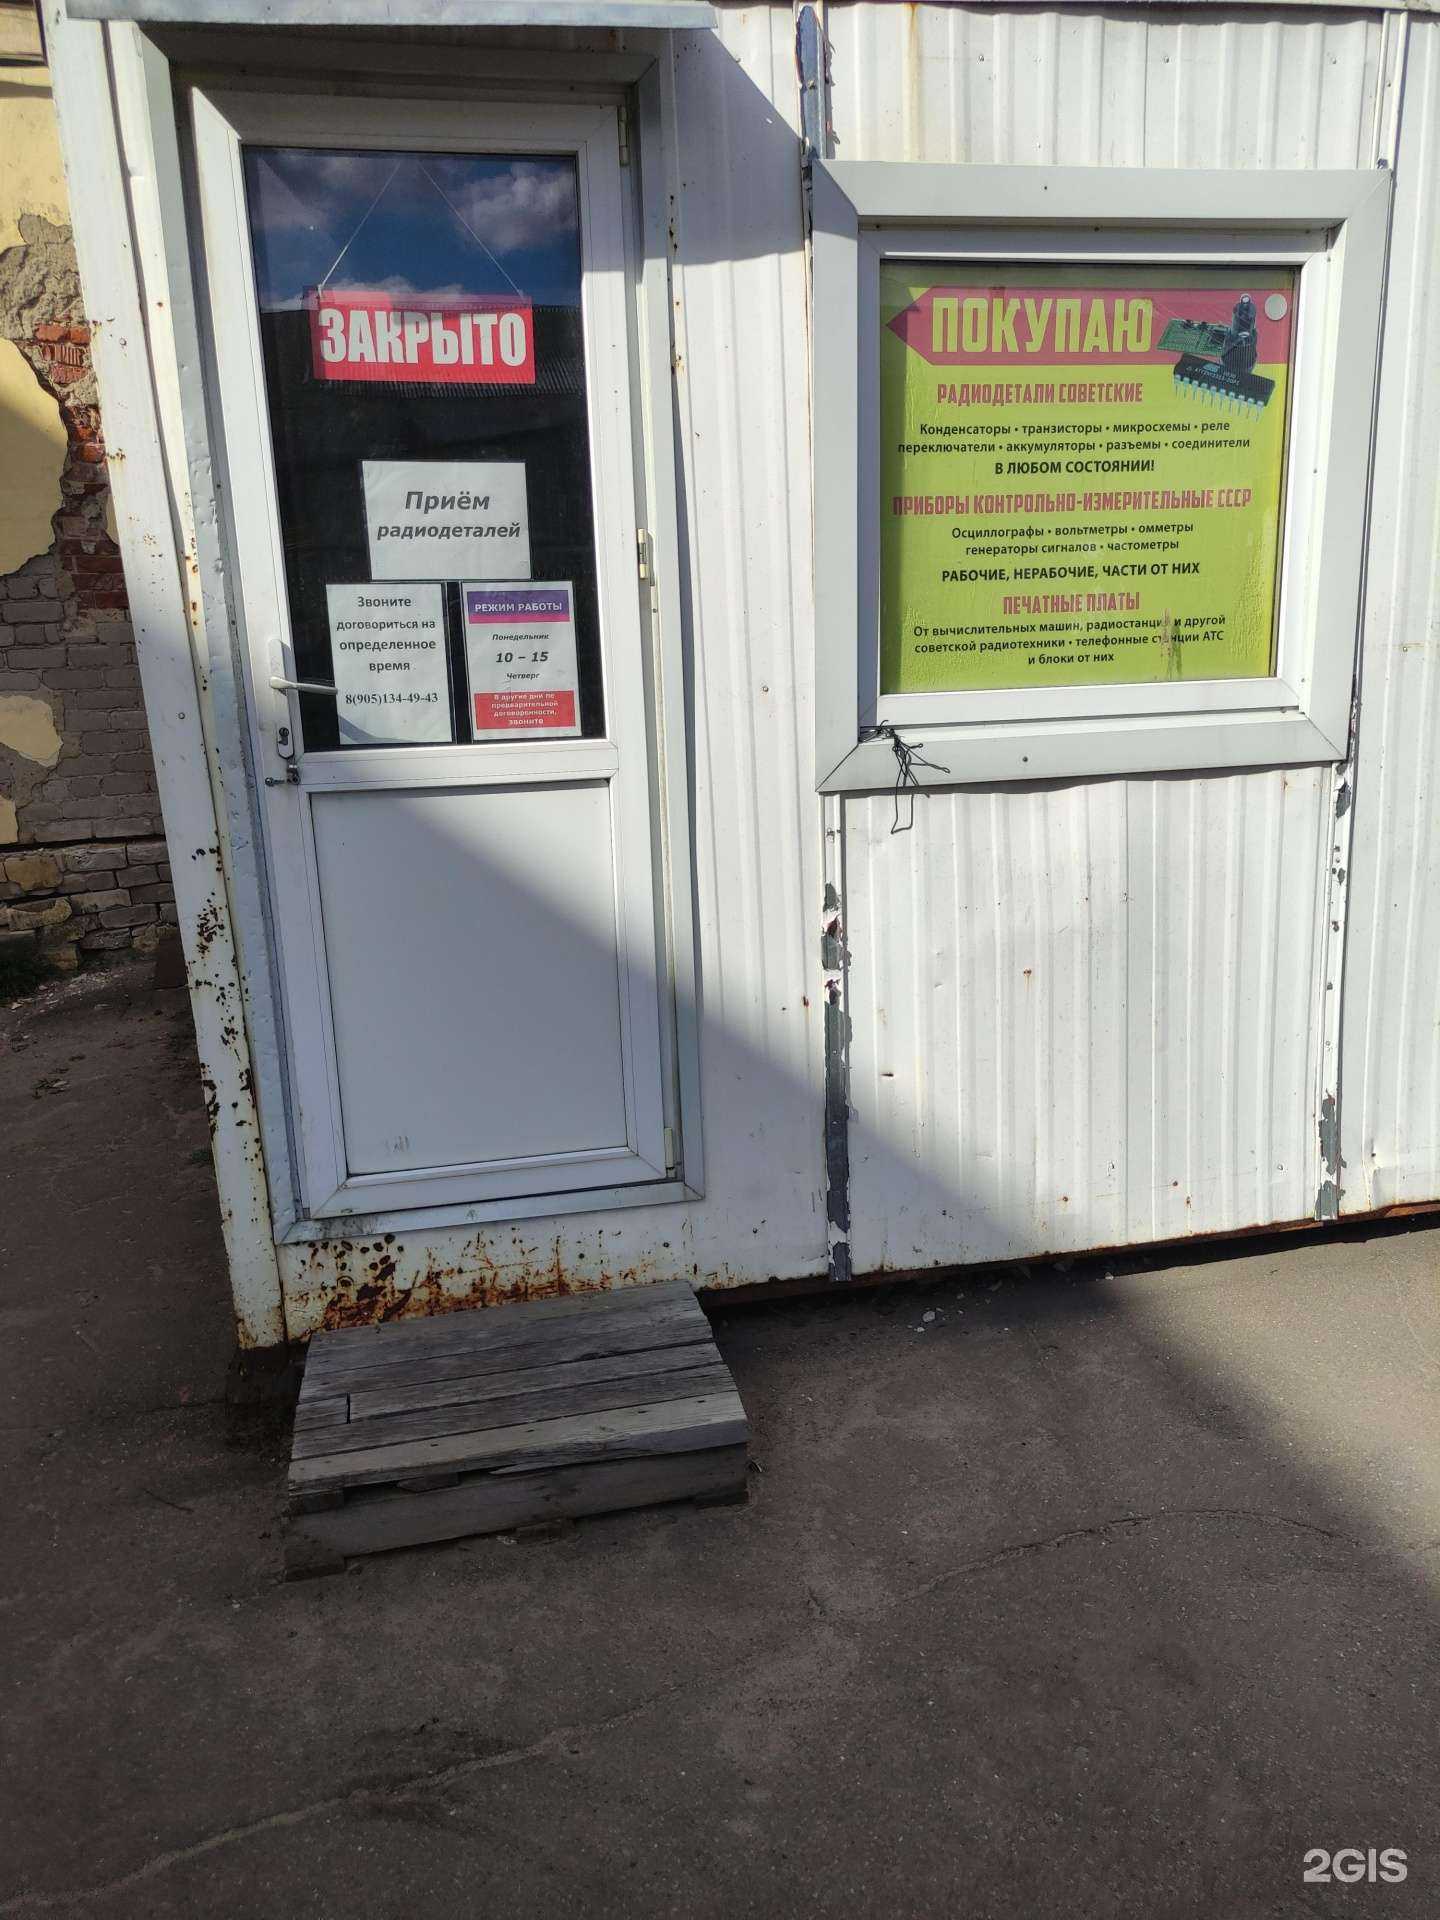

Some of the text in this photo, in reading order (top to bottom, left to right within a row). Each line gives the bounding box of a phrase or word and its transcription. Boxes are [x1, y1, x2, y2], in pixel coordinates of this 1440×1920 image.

[931, 297, 1154, 354] ПОКУПАЮ
[318, 308, 527, 367] ЗАКРЫТО
[937, 382, 1143, 407] РАДИОДЕТАЛИ СОВЕТСКИЕ
[920, 421, 1230, 437] Конденсаторы транзисторы микросхемы реле
[898, 437, 1250, 455] переключатели аккумуляторы разъемы соединители
[995, 460, 1155, 475] В ЛЮБОМ СОСТОЯНИИ!
[404, 490, 489, 514] Приём
[893, 488, 1251, 516] ПРИБОРЫ КОНТРОЛЬНО-ИЗМЕРИТЕЛЬНЫЕ СССР
[377, 521, 520, 541] радиодеталей
[952, 523, 1194, 540] Осциллографы вольтметры омметры
[965, 540, 1179, 556] генераторы сигналов частометры
[942, 562, 1200, 583] РАБОЧИЕ, НЕРАБОЧИЕ, ЧАСТИ ОТ НИХ
[358, 597, 411, 607] Звоните
[475, 602, 562, 612] РЕЖИМ РАБОТЫ
[1003, 591, 1140, 615] ПЕЧАТНЫЕ ПЛАТЫ
[337, 620, 435, 631] договориться на
[913, 615, 1226, 637] От вычислительных машин, радиостанци и другой
[492, 633, 549, 641] Понедельник
[915, 630, 1224, 653] советской радиотехники телефонные стнции АТС
[340, 640, 436, 651] определенное
[495, 652, 513, 663] 10
[531, 651, 549, 662] 15
[1028, 653, 1114, 665] и блоки от них
[369, 662, 410, 672] время
[506, 672, 540, 680] Четверг
[346, 693, 438, 706] 8(905)134-49-43
[491, 701, 559, 709] предварительной
